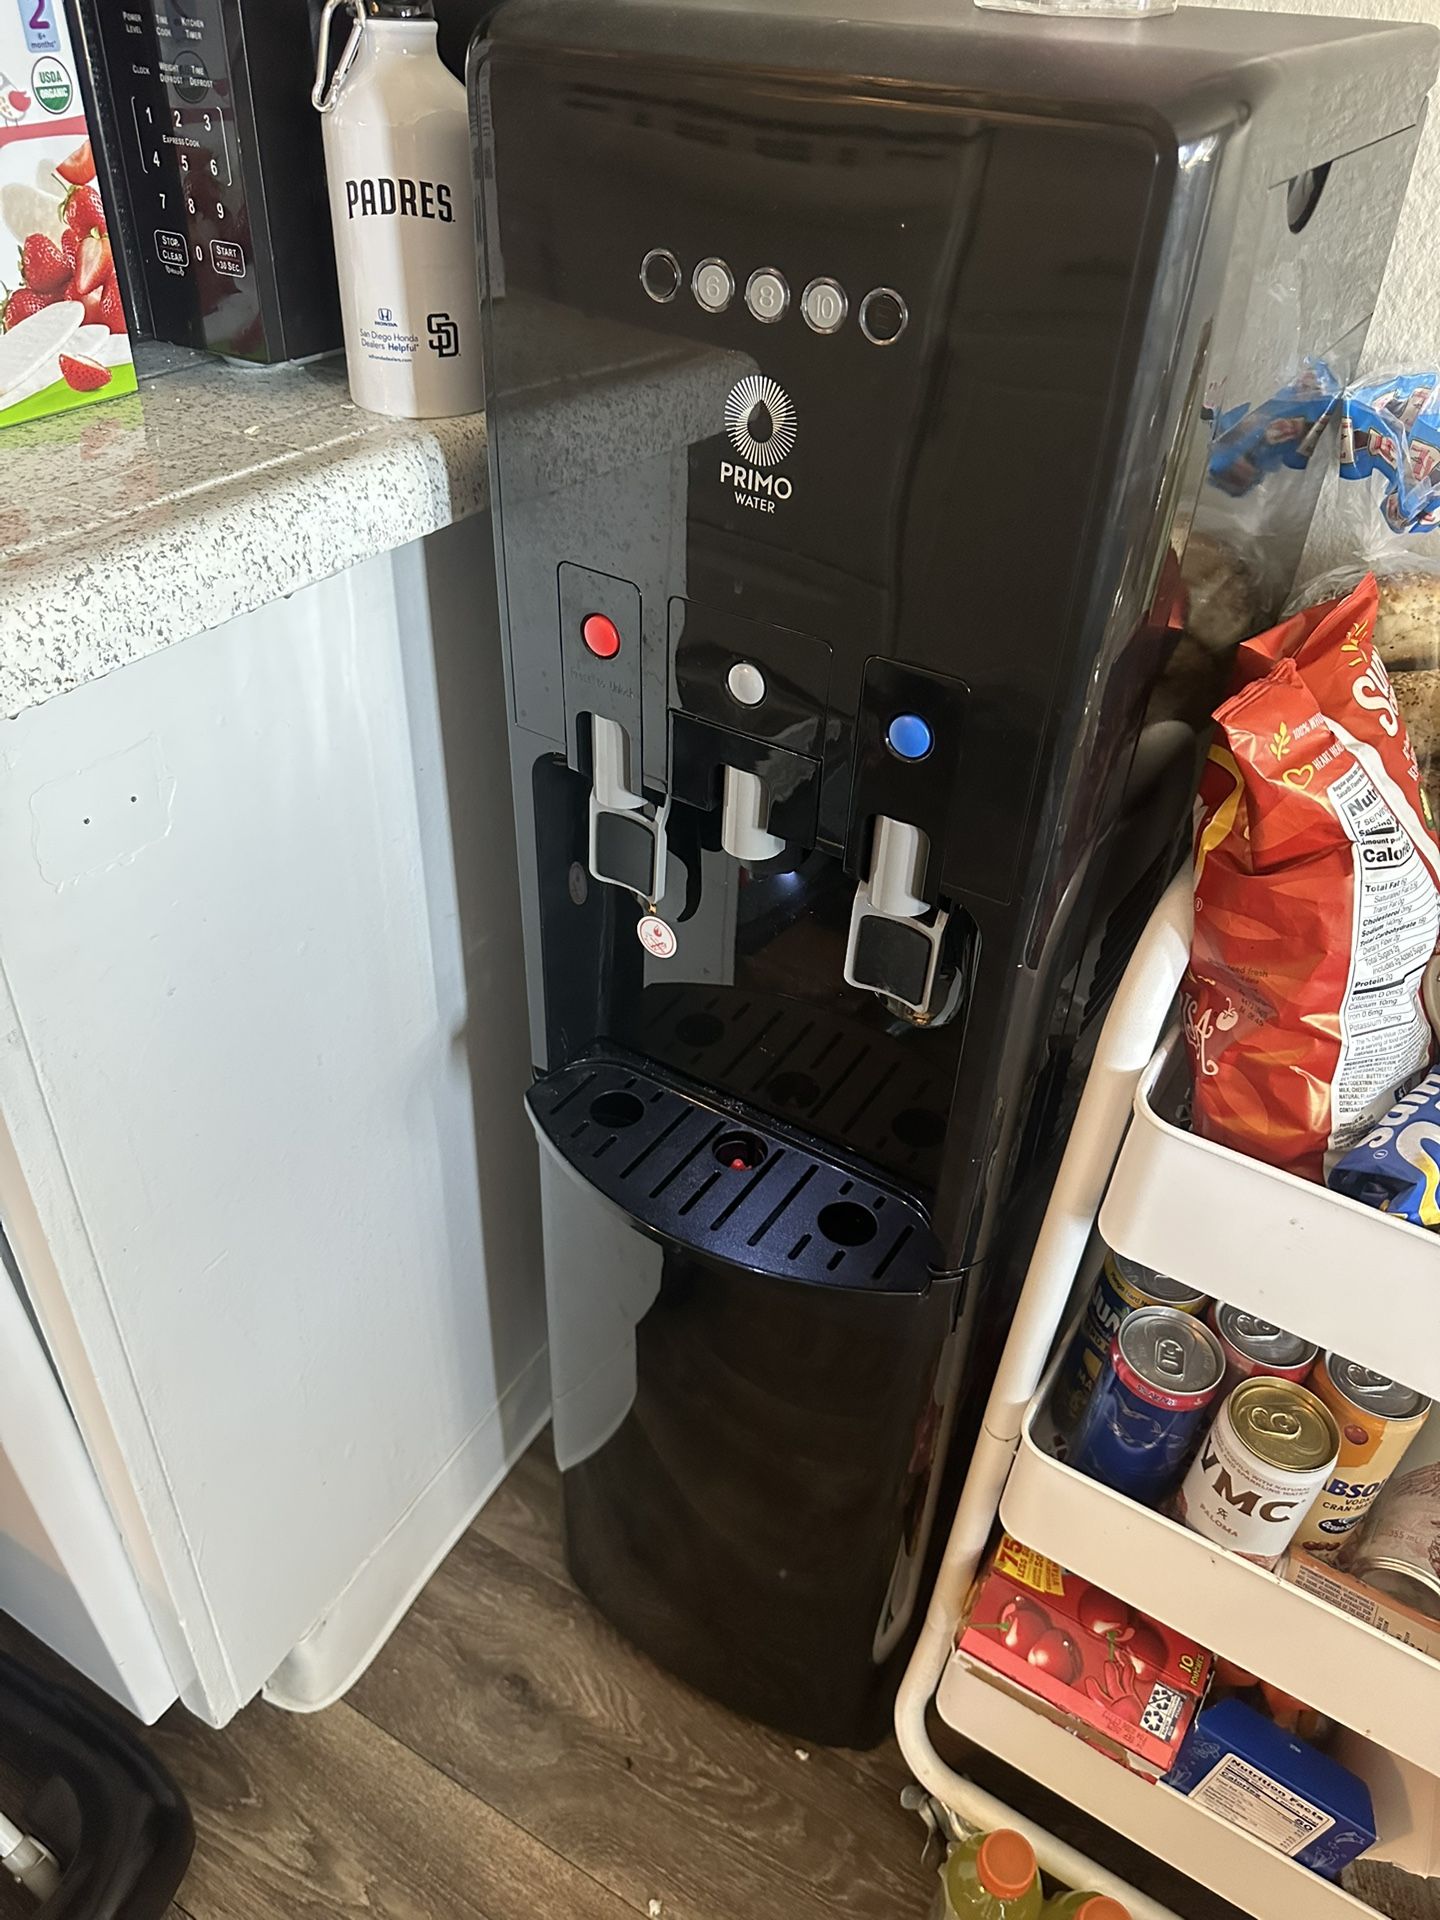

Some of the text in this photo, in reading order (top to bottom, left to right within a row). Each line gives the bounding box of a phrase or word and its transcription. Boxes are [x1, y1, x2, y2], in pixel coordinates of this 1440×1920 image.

[122, 11, 142, 22] POWER
[155, 14, 168, 25] TIME
[181, 17, 204, 28] KITCHEN
[126, 24, 142, 34] LEVEL
[156, 27, 172, 37] COOK
[185, 29, 202, 40] TIMER
[132, 64, 150, 75] CLOCK
[159, 61, 179, 72] WEIGHT
[191, 65, 204, 76] TIME
[39, 71, 63, 84] USDA
[159, 73, 183, 84] DEFROST
[189, 76, 213, 88] DEFROST
[40, 88, 69, 99] ORGANIC
[146, 106, 212, 132] 1 2 3
[162, 134, 201, 148] EXPRESS COOK
[153, 151, 218, 176] 4 5 6
[159, 193, 225, 219] 7 8 9
[346, 178, 453, 223] PADRES
[162, 250, 184, 263] CLEAR
[195, 246, 203, 261] 0
[216, 245, 237, 258] START
[706, 275, 834, 319] 6 8 10
[360, 329, 419, 342] San Diego Honda
[427, 313, 459, 358] SD
[361, 338, 385, 349] Dealers
[720, 461, 793, 500] PRIMO
[735, 491, 776, 514] WATER
[1311, 750, 1333, 771] HEART
[1361, 838, 1389, 846] Amount
[1364, 880, 1400, 893] Total Fat
[1362, 908, 1401, 927] Cholesterol
[1361, 924, 1384, 938] Sodium
[1375, 921, 1417, 940] Carbohydrate
[1373, 960, 1395, 975] Includes
[1354, 976, 1385, 988] Protein
[1351, 993, 1377, 1002] Vitamin
[1348, 1002, 1377, 1010] Calcium
[1349, 1018, 1382, 1032] Potassium
[1199, 1503, 1239, 1538] PALOMA
[998, 1536, 1023, 1568] 75
[1179, 1655, 1194, 1673] 10
[1190, 1653, 1204, 1686] POUCHES
[1231, 1759, 1286, 1797] Nutrition
[1290, 1797, 1324, 1821] Facts
